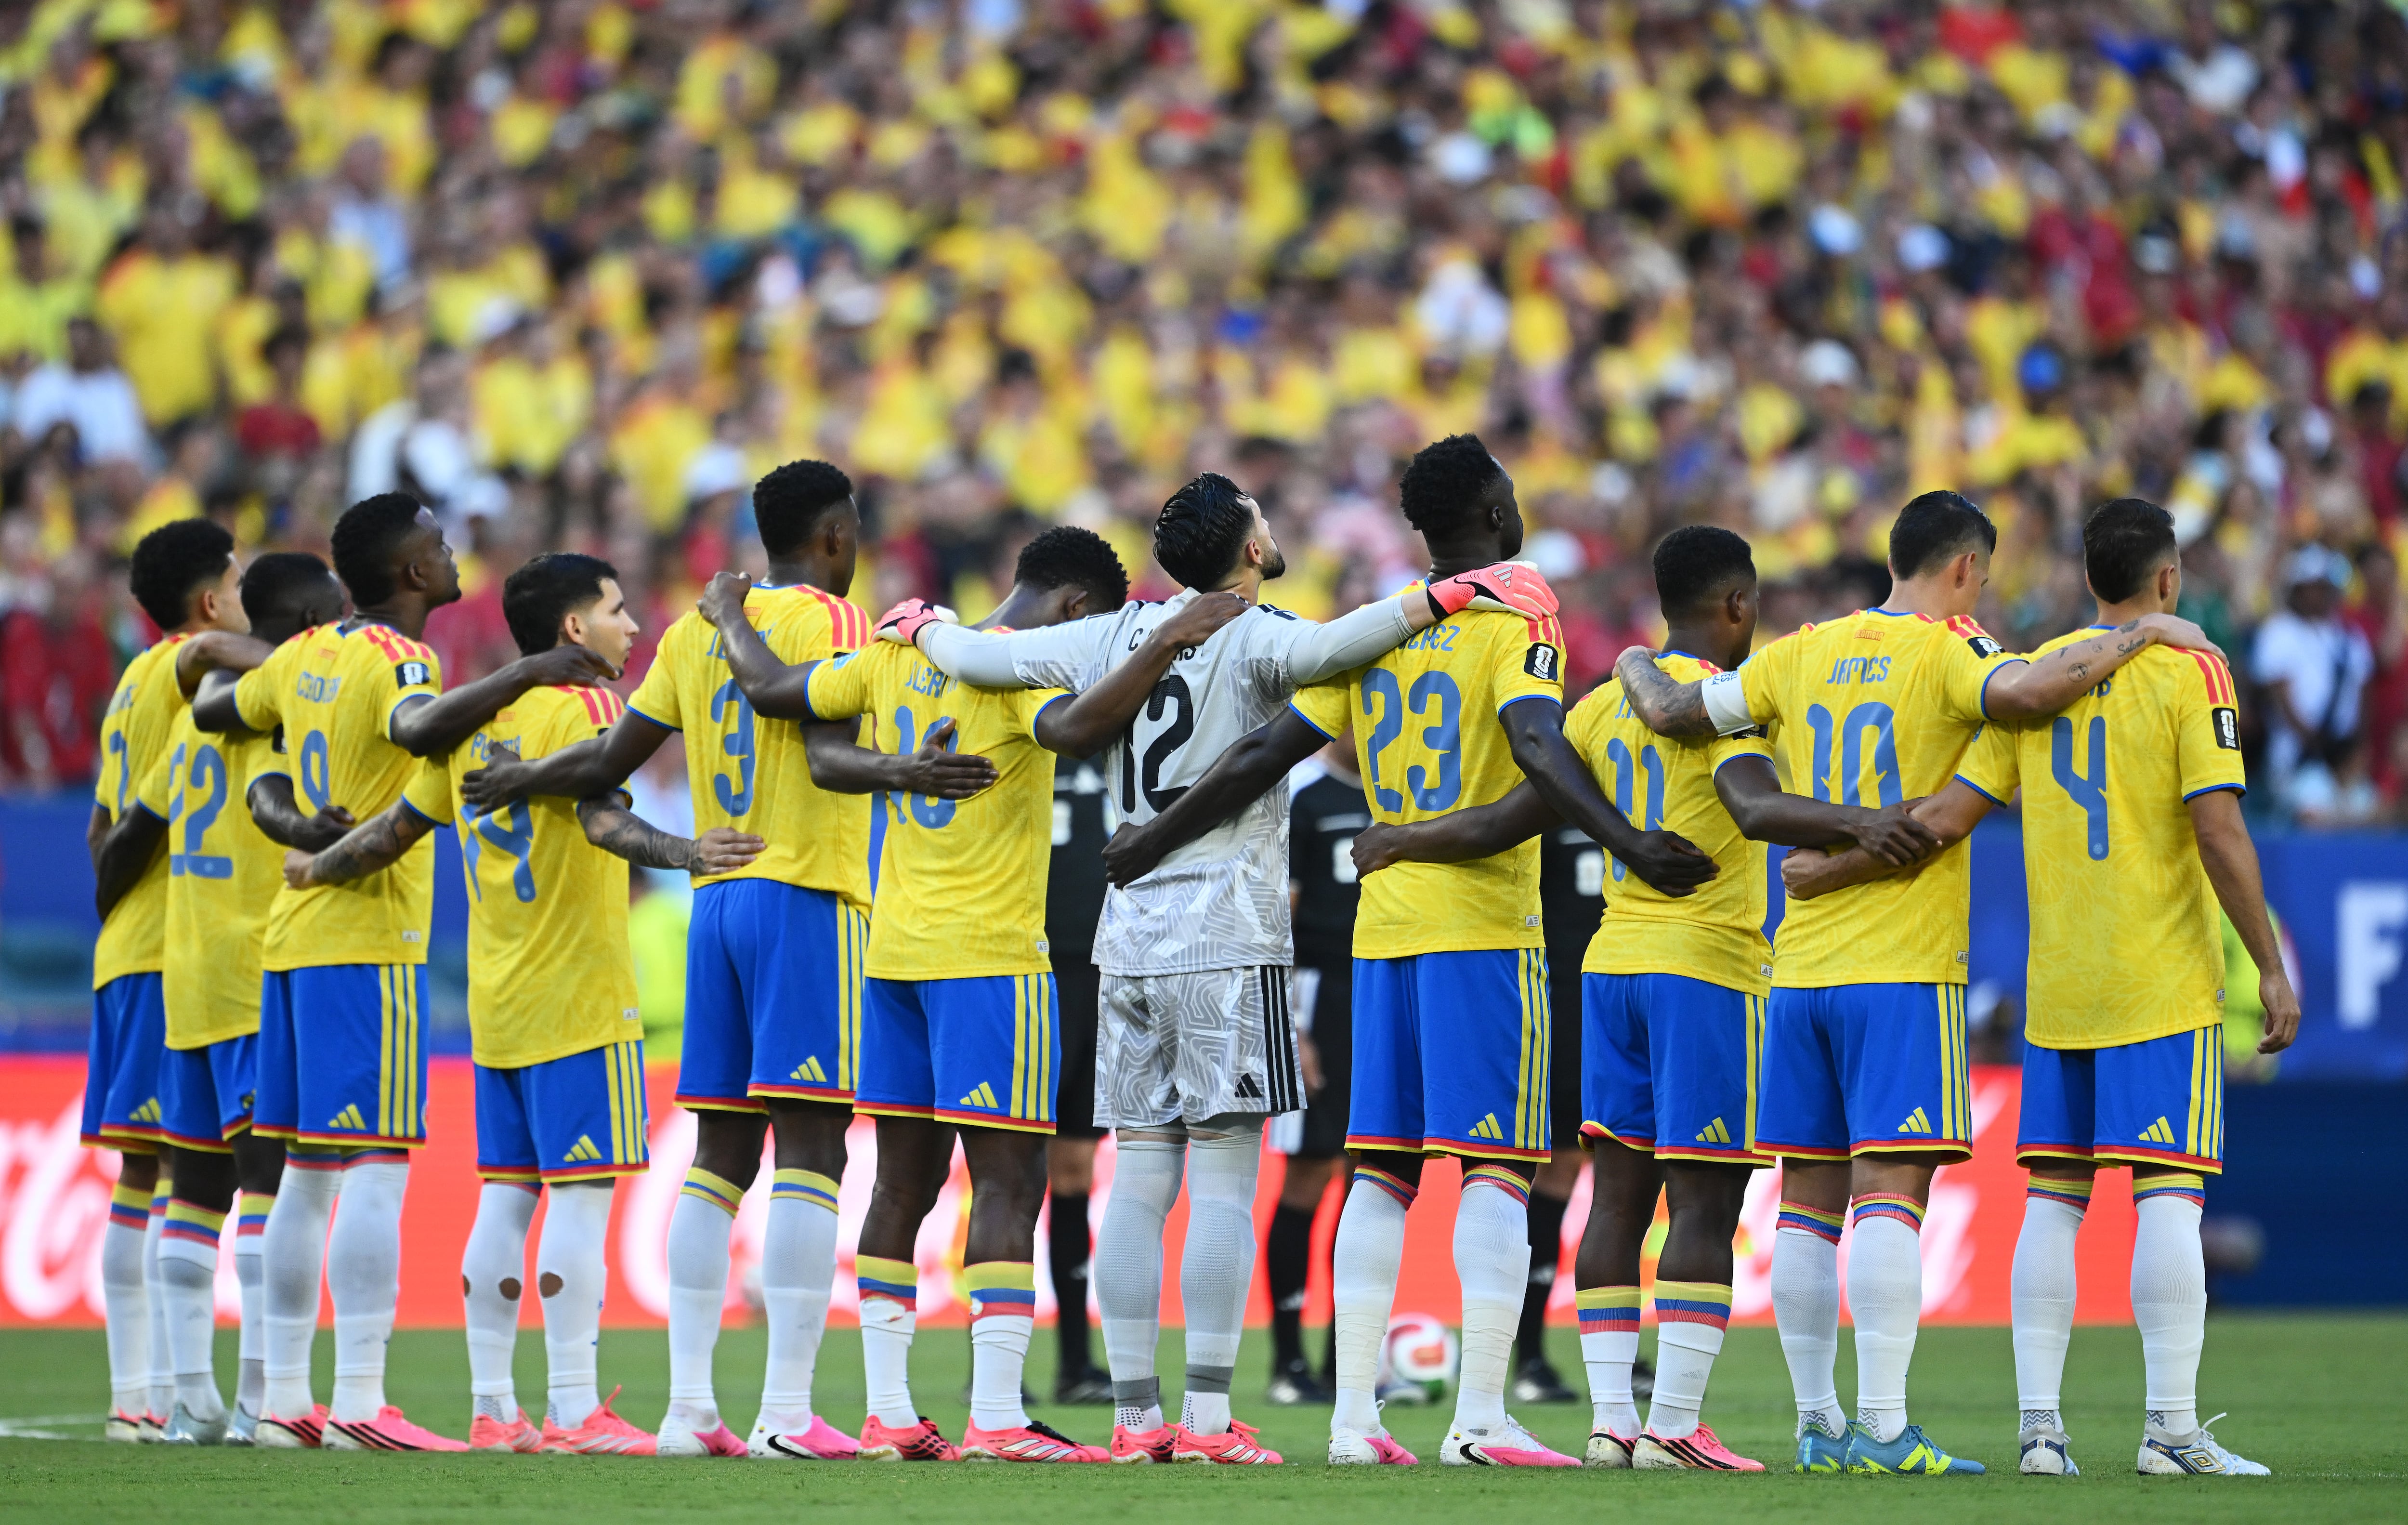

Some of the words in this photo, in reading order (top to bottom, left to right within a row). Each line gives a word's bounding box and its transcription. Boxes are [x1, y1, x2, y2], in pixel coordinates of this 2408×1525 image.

[1826, 656, 1891, 685] JAMES
[301, 730, 329, 810] 9
[711, 678, 755, 817] 3
[1122, 674, 1194, 814] 12
[1361, 668, 1461, 813] 23
[1607, 738, 1665, 882] 11
[1806, 702, 1903, 809] 10
[2052, 716, 2109, 861] 4
[169, 743, 233, 879] 22
